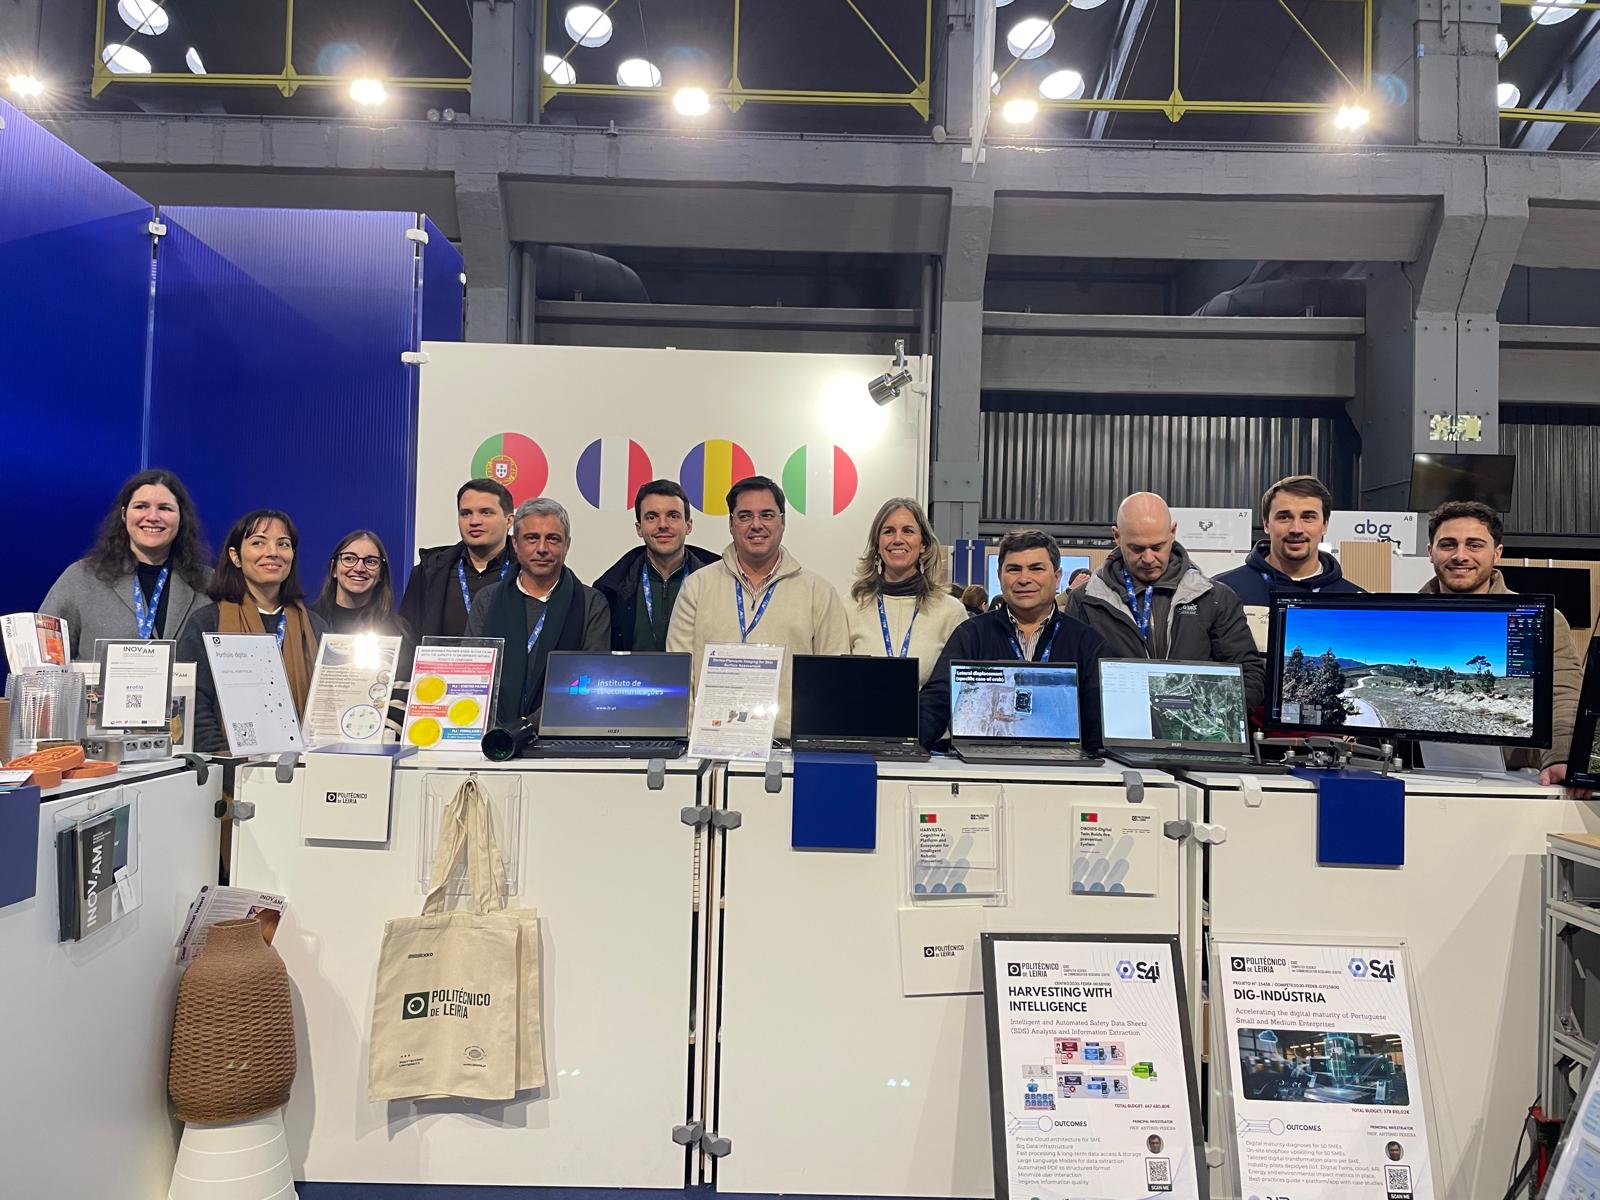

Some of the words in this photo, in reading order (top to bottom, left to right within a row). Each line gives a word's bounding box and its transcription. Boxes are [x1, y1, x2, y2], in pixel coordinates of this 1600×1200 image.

[1354, 519, 1392, 539] abg
[1022, 962, 1059, 970] POLITÉCNICO
[1246, 956, 1286, 966] POLITÉCNICO
[432, 988, 490, 1006] POLITÉCNICO
[1008, 986, 1081, 998] HARVESTING
[1083, 988, 1112, 998] WITH
[1234, 988, 1326, 1003] DIG-INDÚSTRIA
[430, 1008, 440, 1016] DE
[444, 1004, 468, 1018] LEIRIA
[1010, 1001, 1087, 1012] INTELLIGENCE
[1236, 1008, 1276, 1016] Accelerating
[1312, 1011, 1340, 1019] maturity
[1351, 1012, 1386, 1020] Portuguese
[1299, 1020, 1335, 1028] Enterprises
